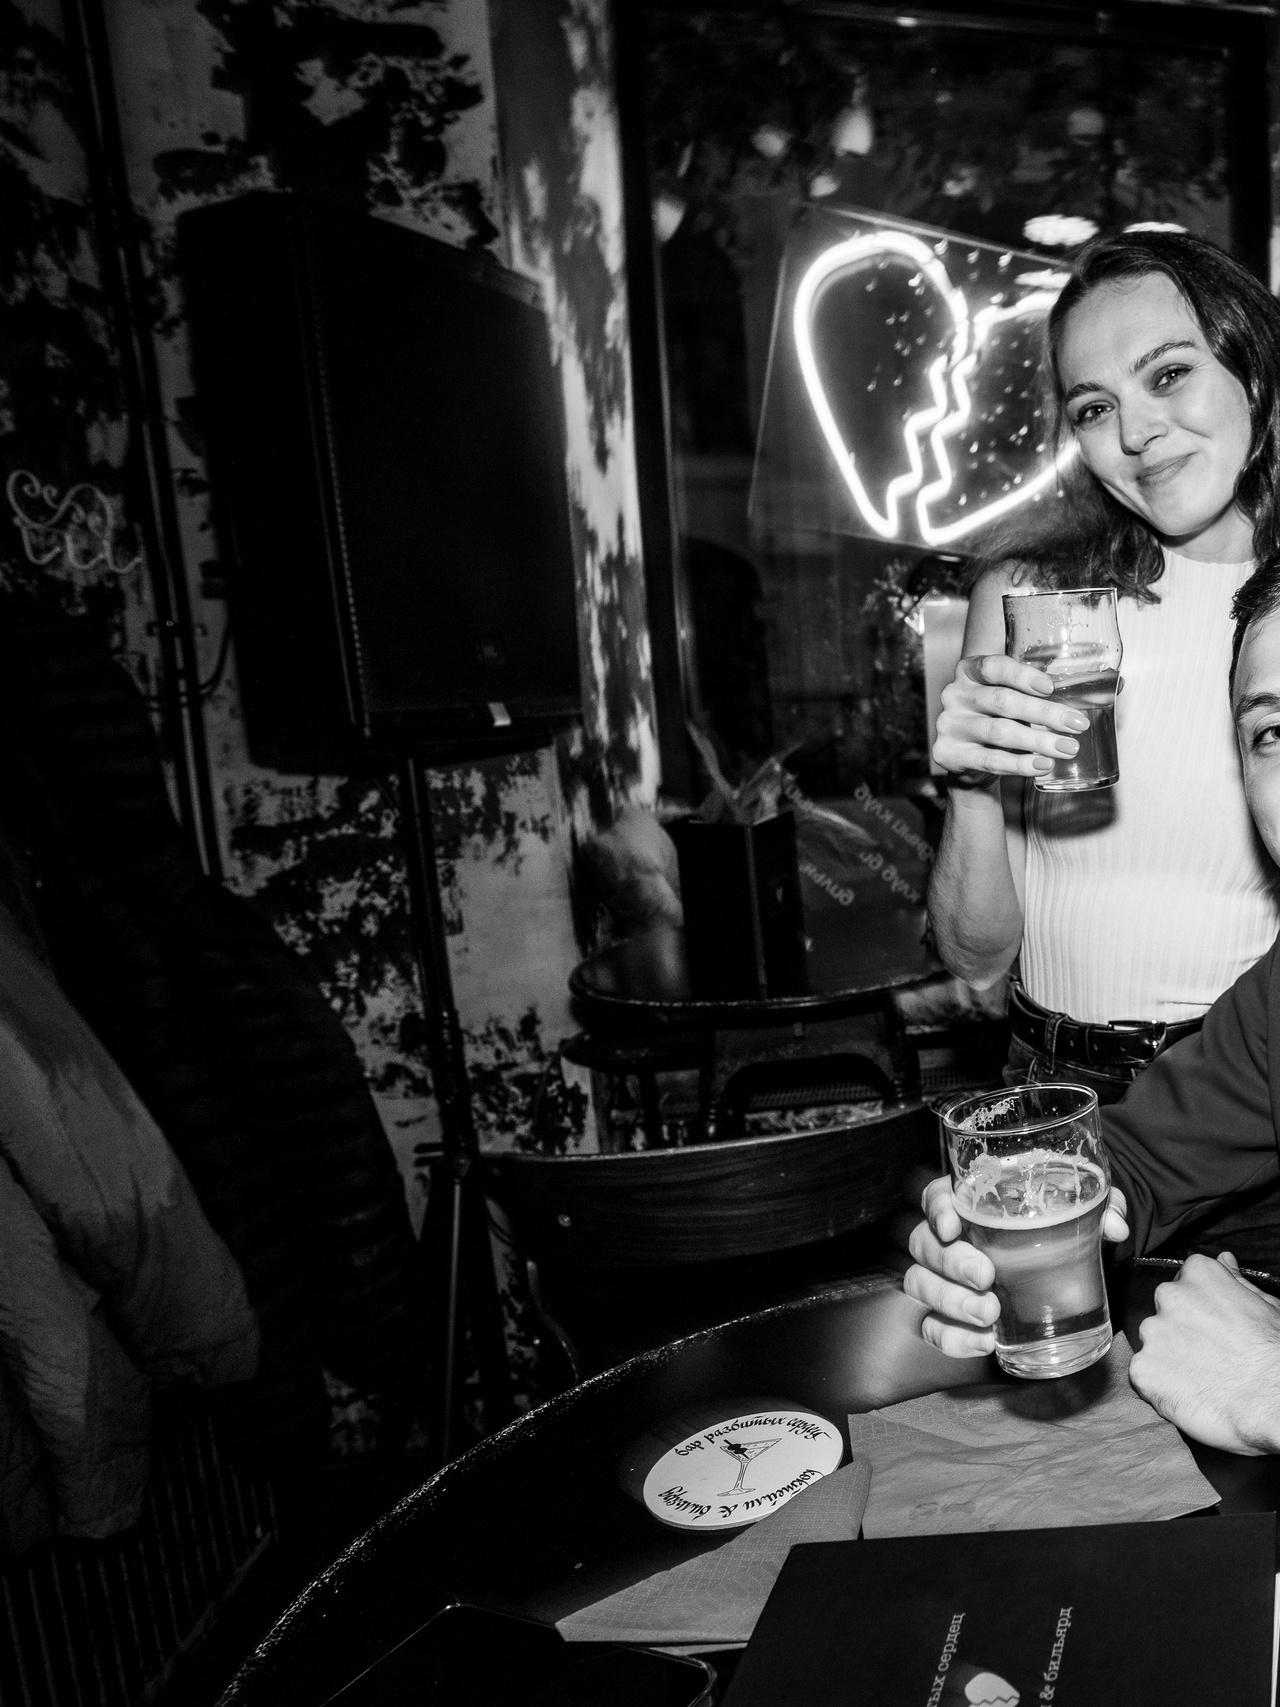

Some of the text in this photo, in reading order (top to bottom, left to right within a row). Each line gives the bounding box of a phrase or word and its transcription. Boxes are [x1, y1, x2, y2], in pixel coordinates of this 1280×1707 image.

[674, 1414, 832, 1456] бар разбитых сердец
[937, 1612, 967, 1672] сердец
[1042, 1606, 1074, 1682] бильярд
